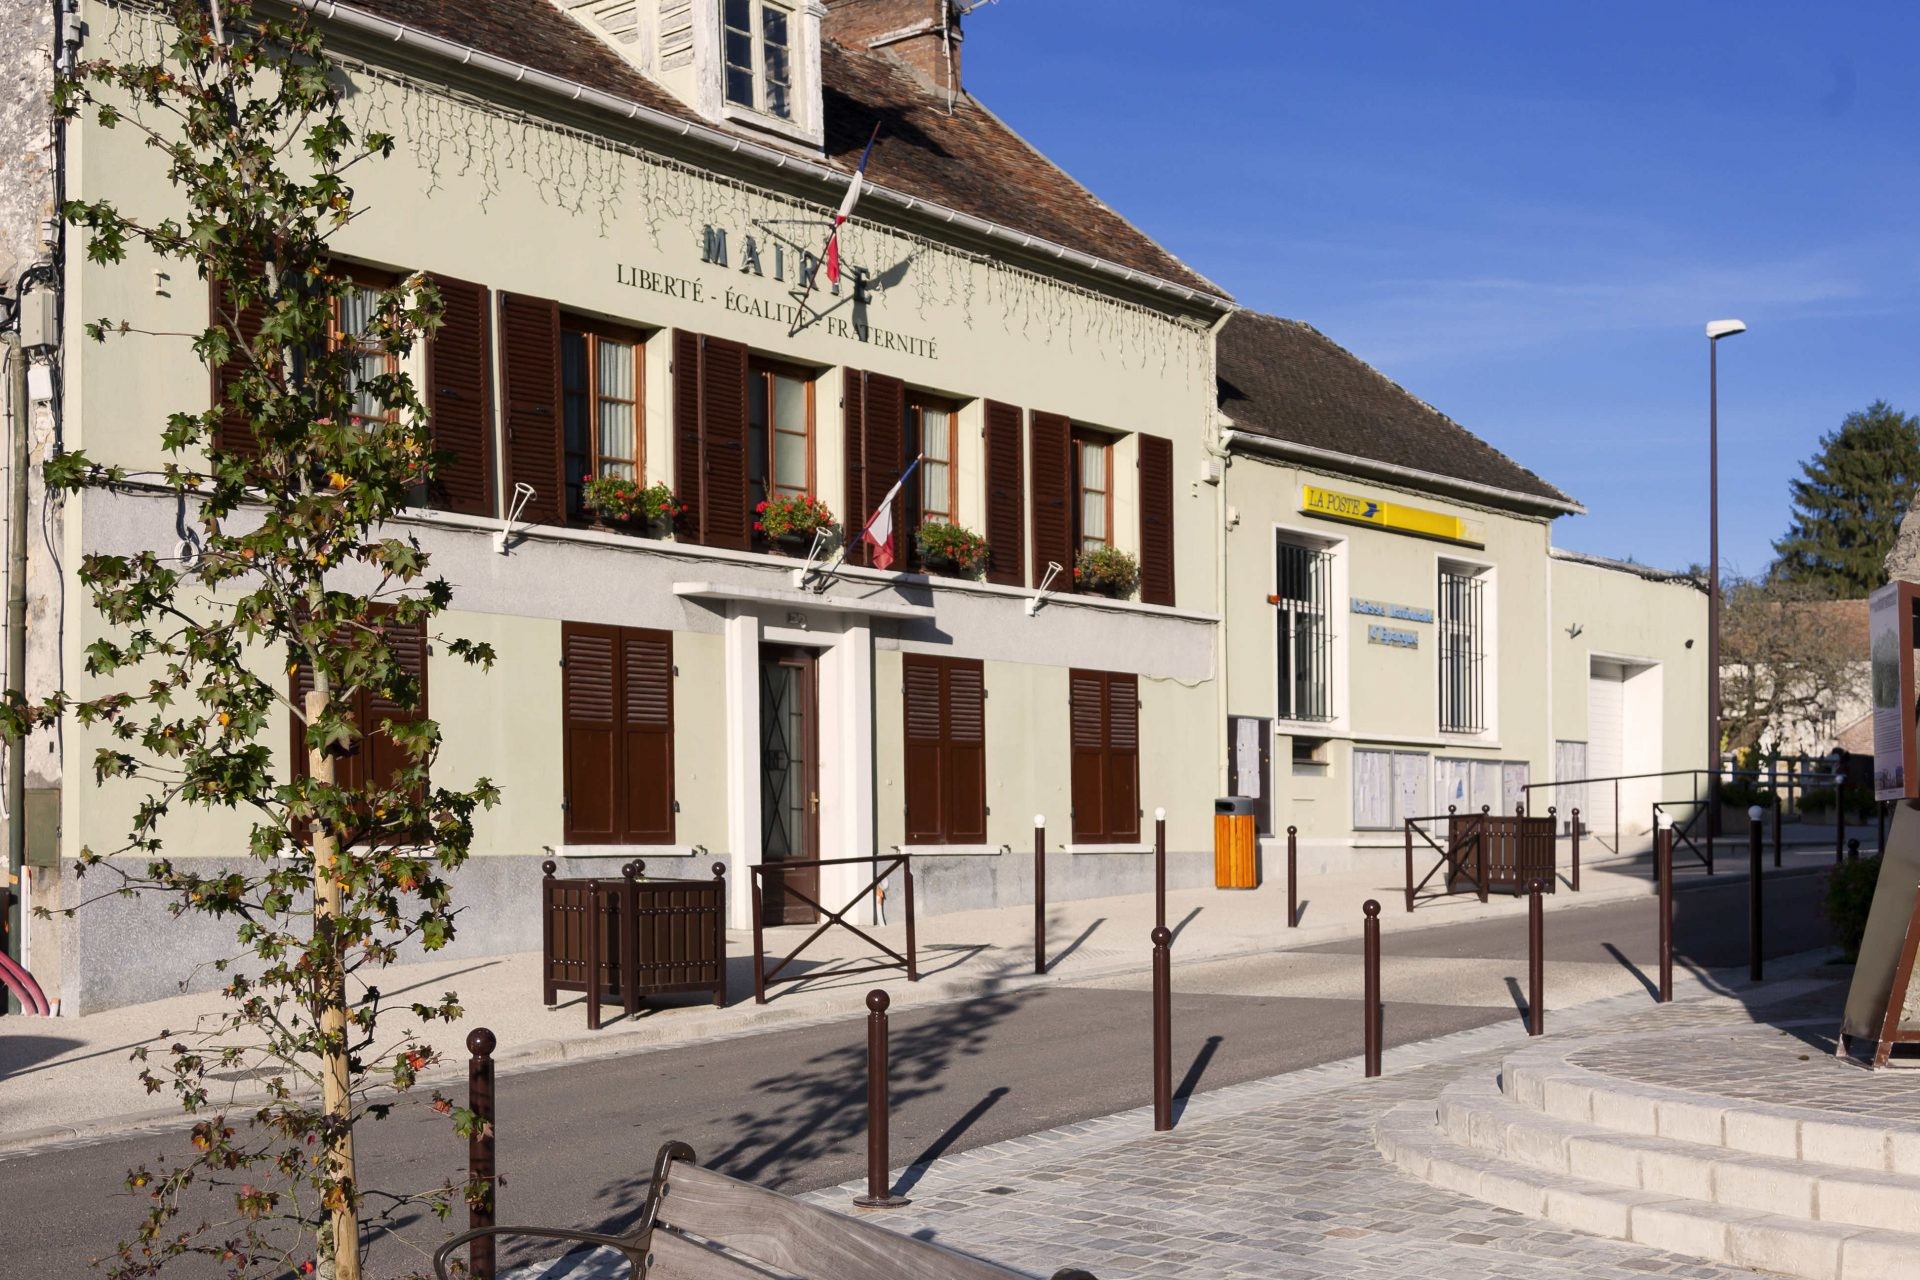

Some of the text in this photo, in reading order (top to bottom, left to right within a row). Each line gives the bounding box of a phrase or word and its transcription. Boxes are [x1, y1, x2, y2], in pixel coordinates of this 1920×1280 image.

[701, 223, 872, 305] MAIRE
[617, 263, 704, 303] LIBERTÉ
[827, 315, 938, 360] FRATERNITÉ
[1309, 490, 1360, 515] LA POSTE
[1352, 598, 1385, 617] Caisse
